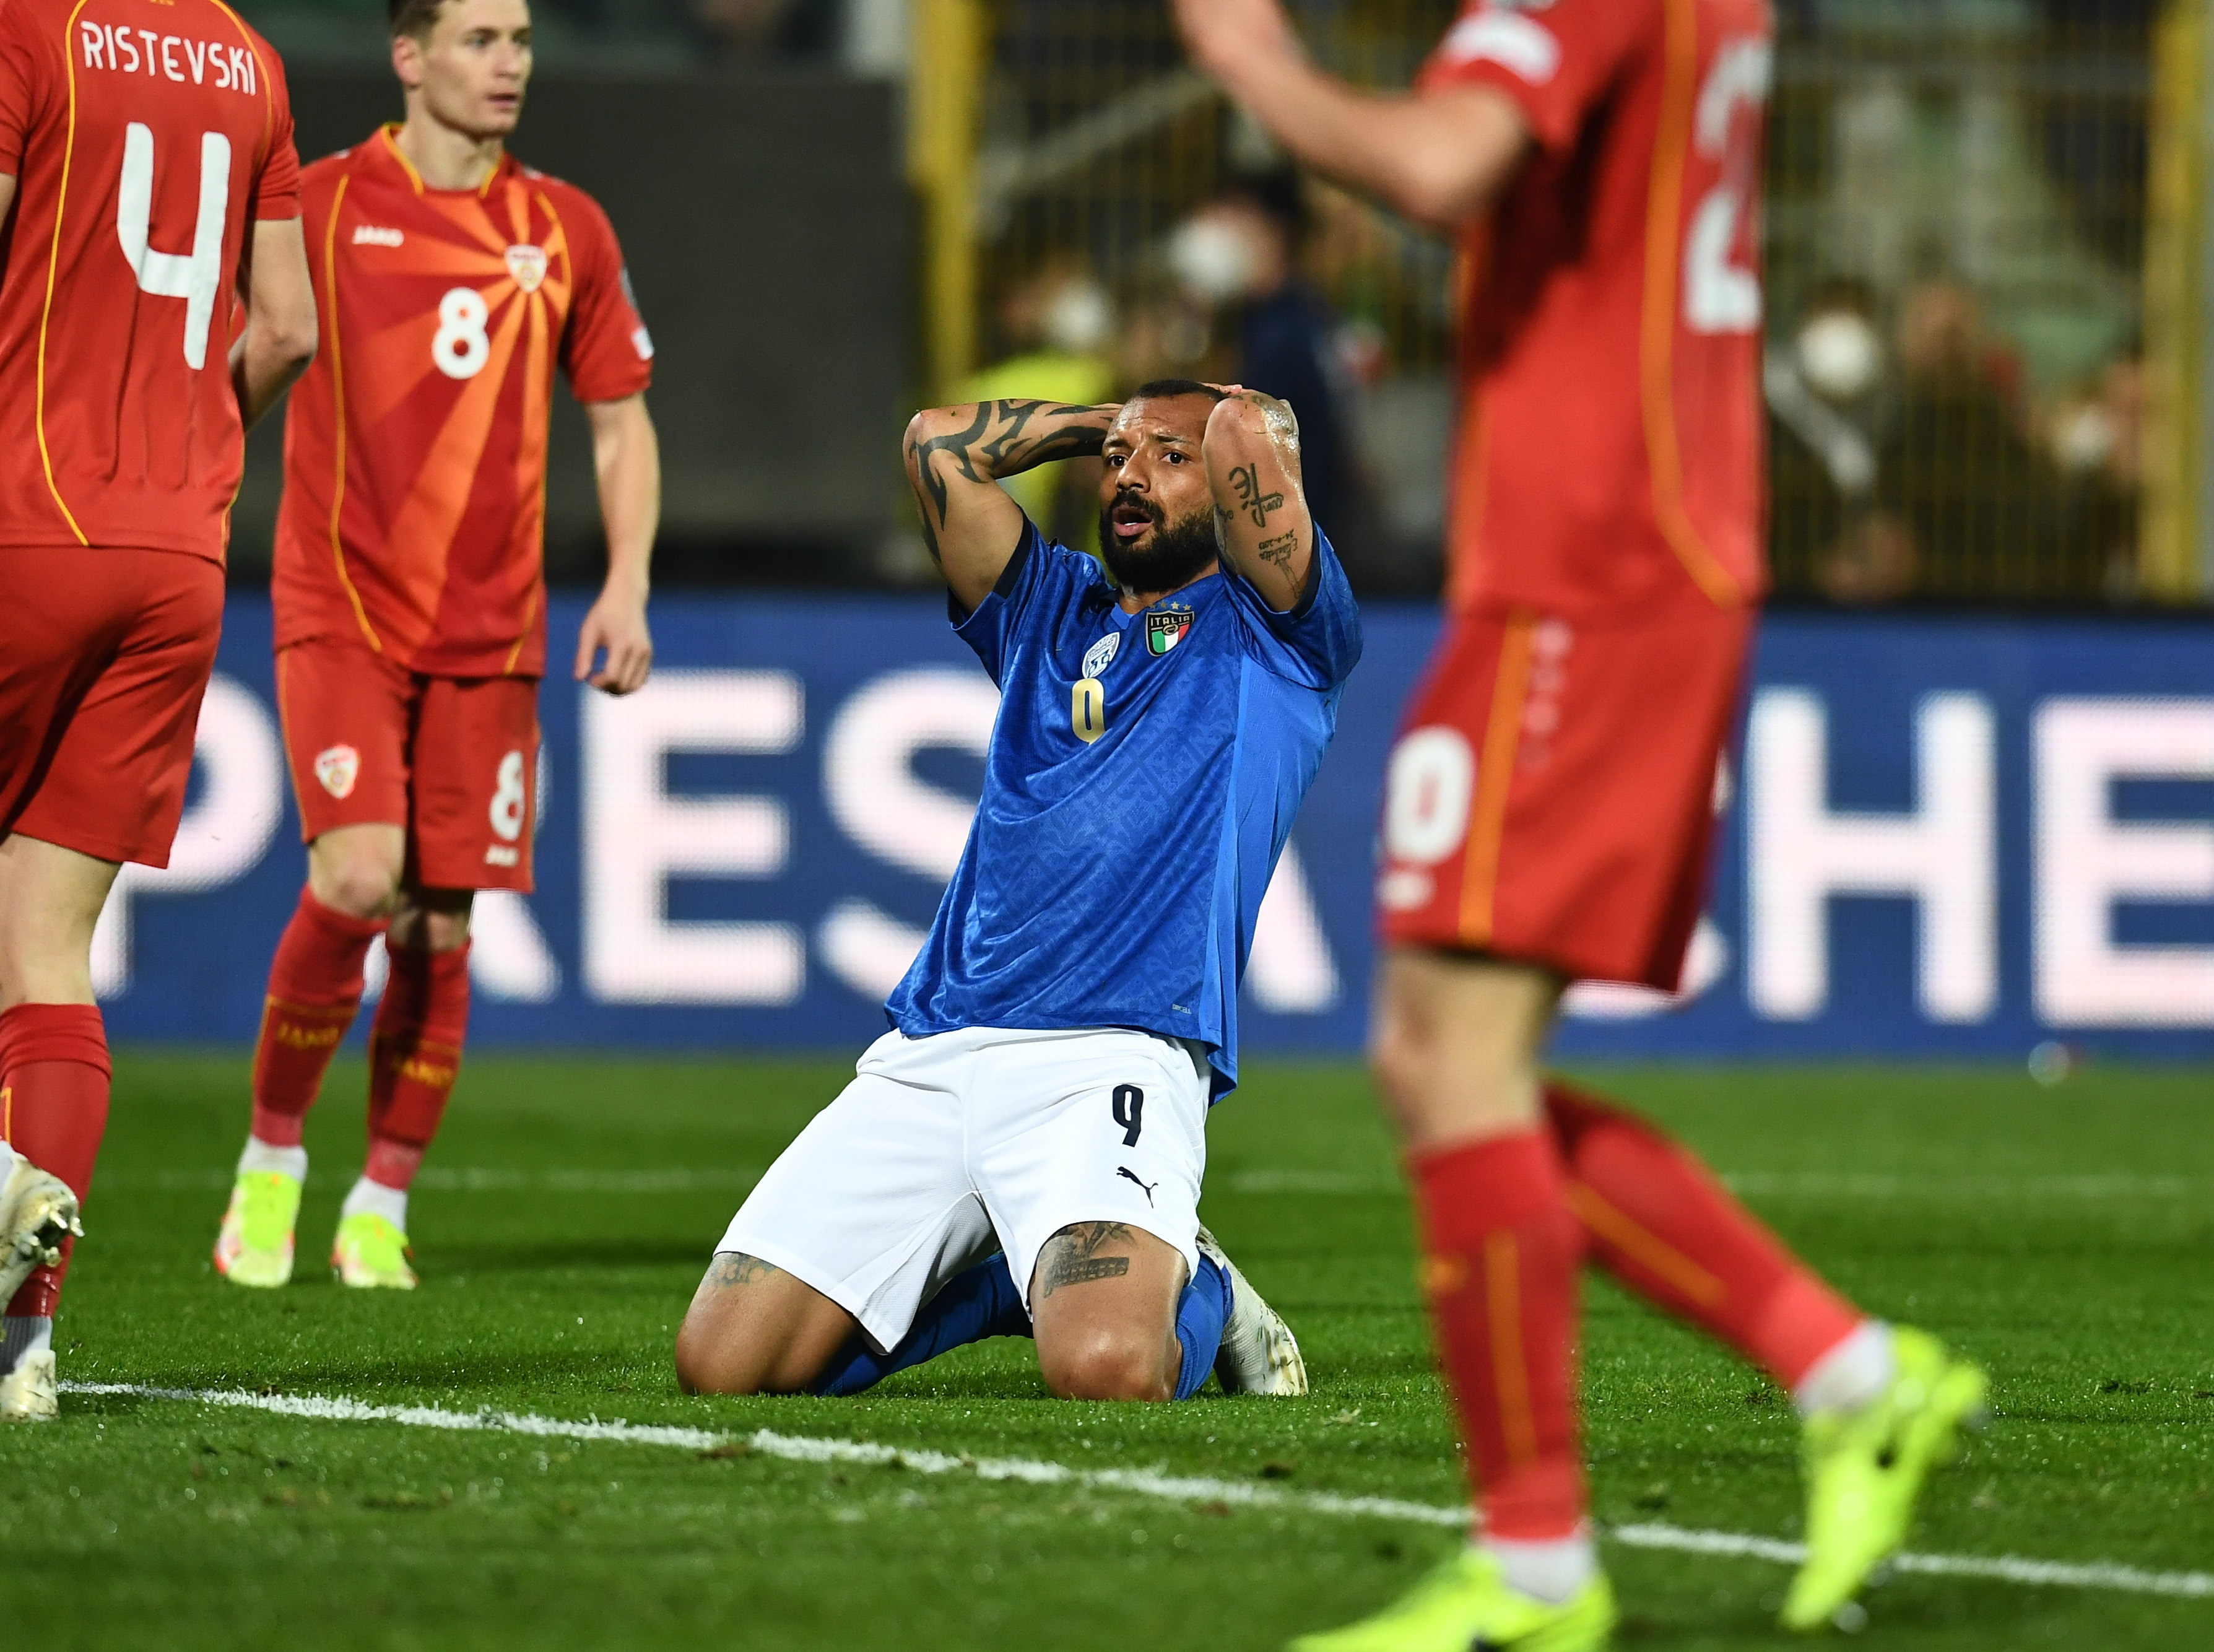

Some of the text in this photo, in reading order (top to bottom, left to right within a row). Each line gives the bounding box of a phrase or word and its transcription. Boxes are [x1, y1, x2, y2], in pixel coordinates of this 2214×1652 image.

[80, 20, 256, 95] RISTEVSKI
[117, 121, 231, 370] 4
[433, 287, 489, 379] 8
[1150, 615, 1191, 627] ITALIA
[490, 750, 524, 841] 8
[1112, 1084, 1144, 1148] 9
